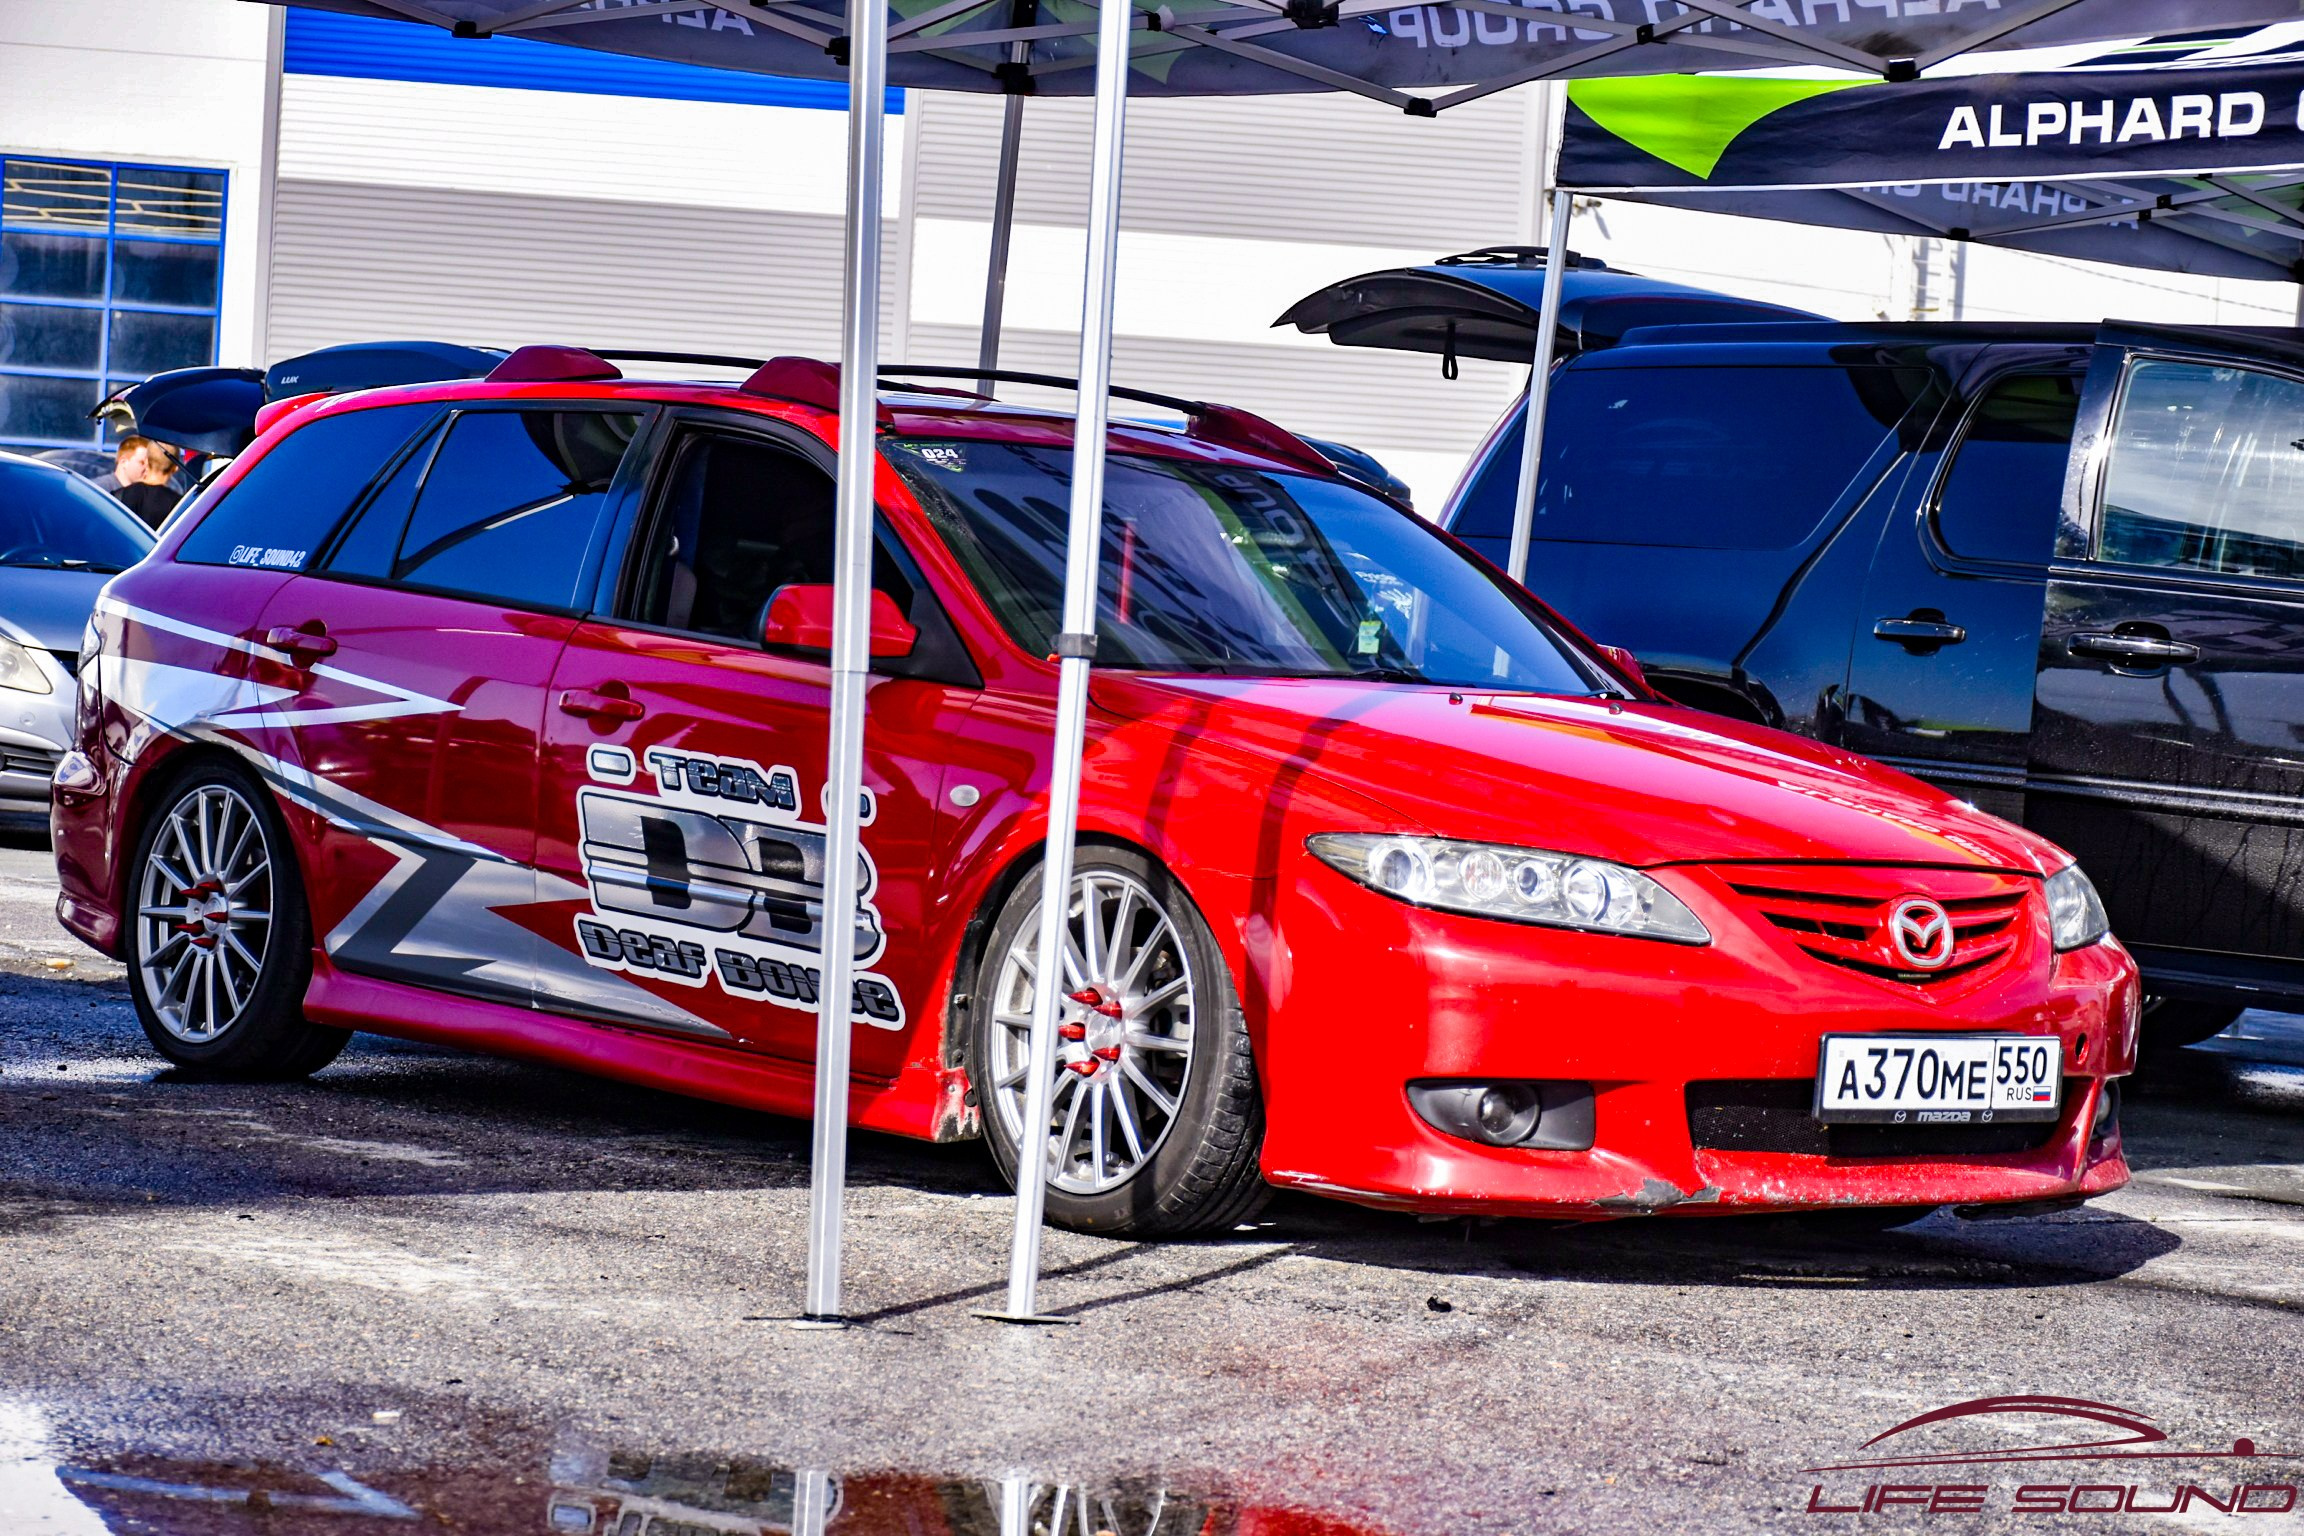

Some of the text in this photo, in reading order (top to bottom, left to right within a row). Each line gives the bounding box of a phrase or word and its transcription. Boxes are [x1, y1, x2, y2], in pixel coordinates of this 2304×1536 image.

[1937, 90, 2266, 150] ALPHARD
[280, 375, 299, 385] LUX
[921, 448, 959, 459] 024
[1836, 1045, 2048, 1101] A370ME 550
[2006, 1087, 2033, 1102] RUS
[1916, 1110, 1972, 1123] mazda
